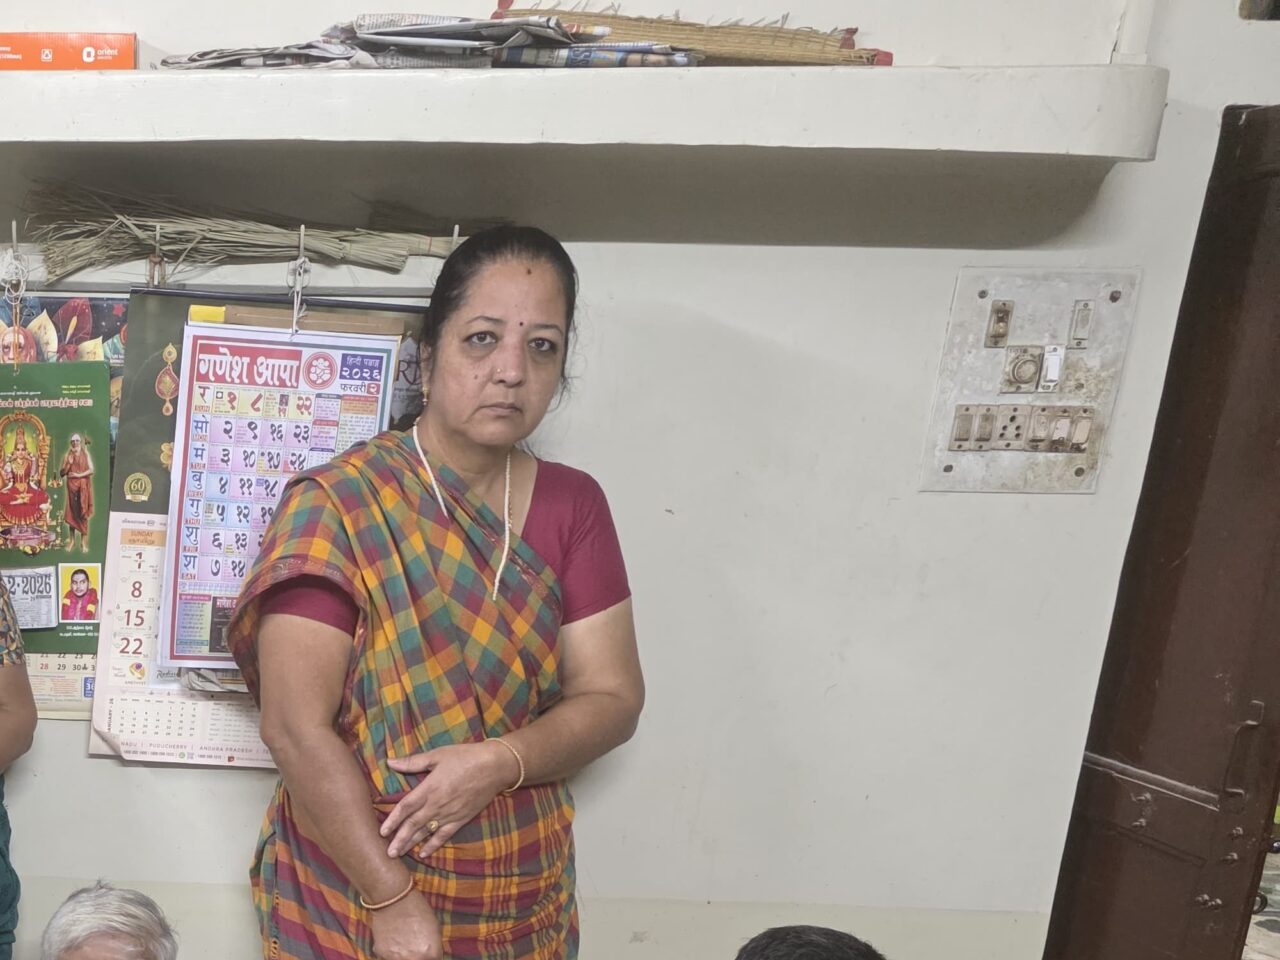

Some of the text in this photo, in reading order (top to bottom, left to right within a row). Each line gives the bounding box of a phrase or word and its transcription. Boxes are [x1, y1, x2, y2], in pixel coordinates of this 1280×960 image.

[199, 347, 300, 387] गणेश आपा
[341, 367, 381, 380] २०२६
[340, 382, 366, 393] फरवरी
[198, 386, 210, 404] र
[227, 391, 237, 410] १
[251, 392, 263, 412] ८
[296, 396, 312, 416] २२
[193, 414, 310, 443] सो २ ९ १६ २३
[193, 443, 306, 471] मं ३ १० १७ २४
[131, 480, 145, 491] 60
[191, 470, 278, 498] बु ४ ११ १८
[188, 498, 202, 517] गु
[216, 504, 226, 522] ५
[236, 505, 250, 523] १२
[185, 526, 200, 546] शु
[212, 532, 222, 550] ६
[235, 533, 248, 550] १३
[183, 554, 245, 578] श ७ १४
[131, 580, 142, 598] 8
[124, 609, 145, 627] 15
[119, 637, 143, 655] 22
